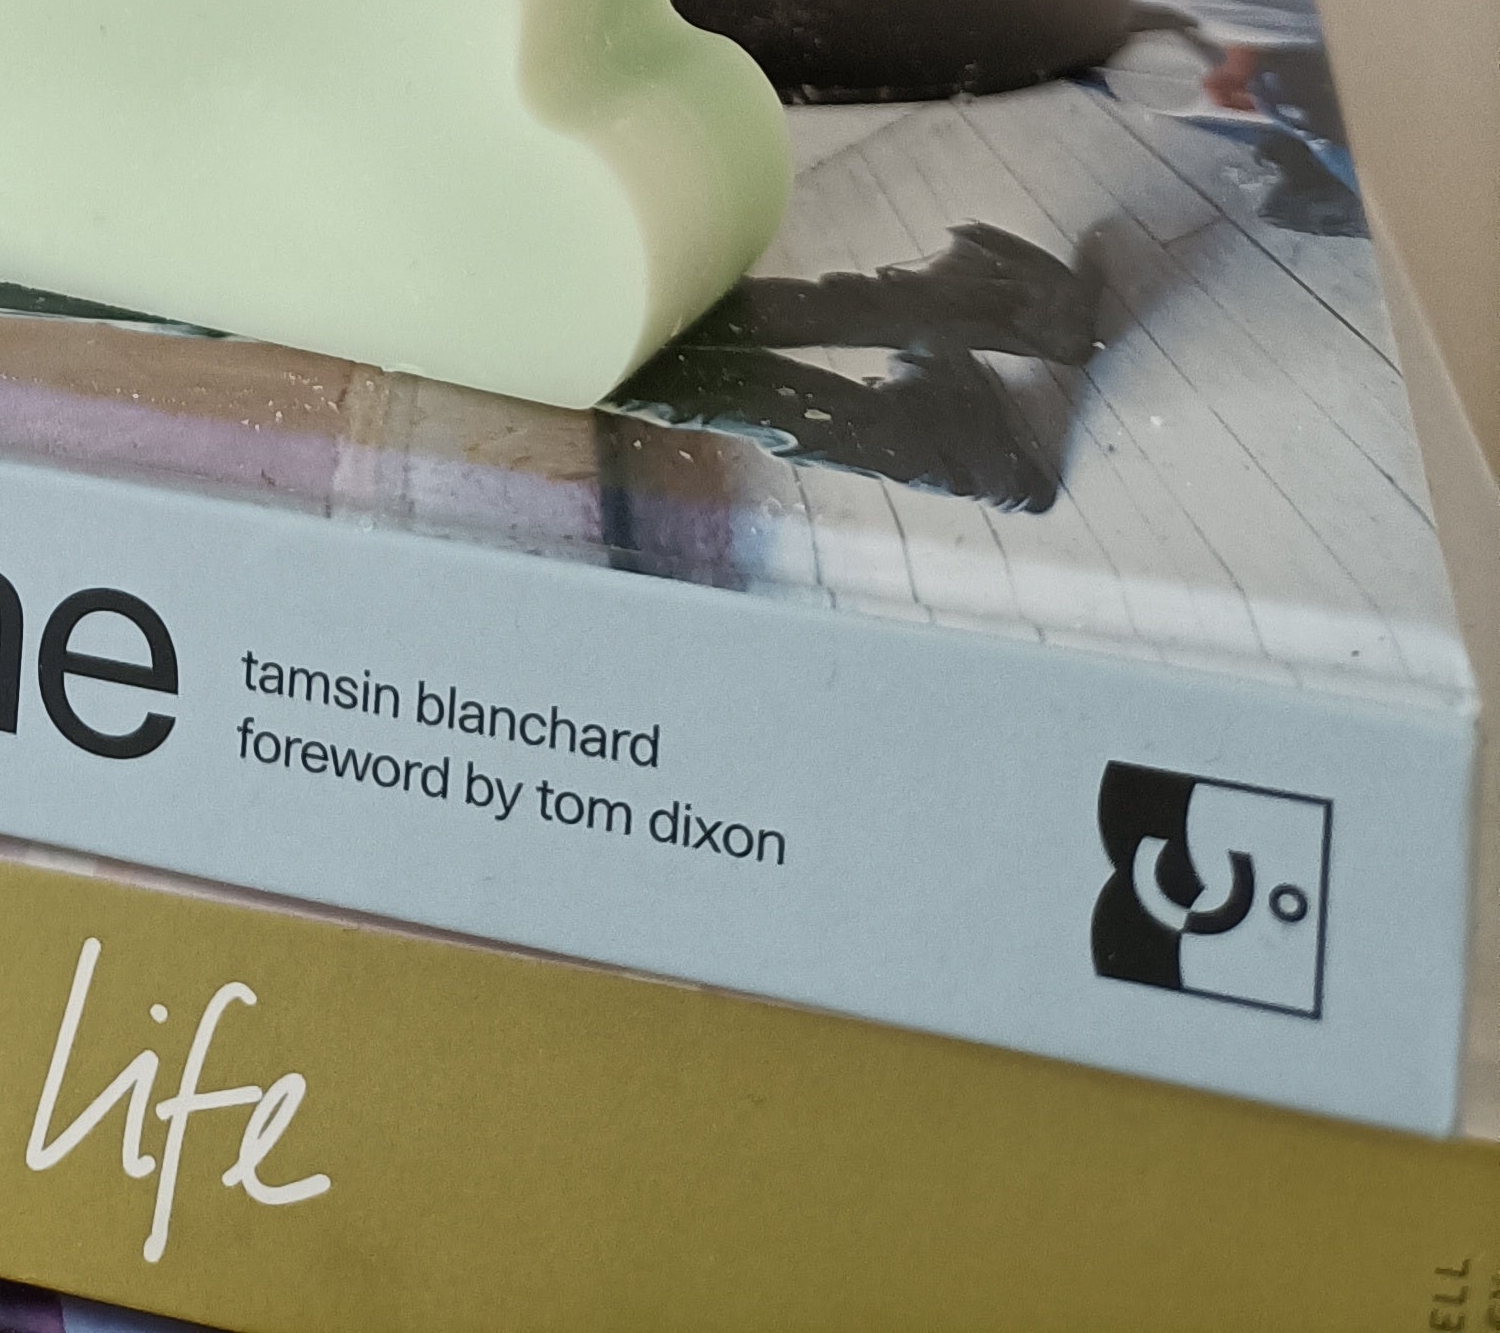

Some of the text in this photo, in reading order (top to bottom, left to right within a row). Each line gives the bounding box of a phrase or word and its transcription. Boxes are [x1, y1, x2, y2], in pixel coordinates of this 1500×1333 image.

[241, 649, 661, 769] tamsin blanchard
[236, 716, 787, 866] foreword by tom dixon
[25, 936, 332, 1264] life
